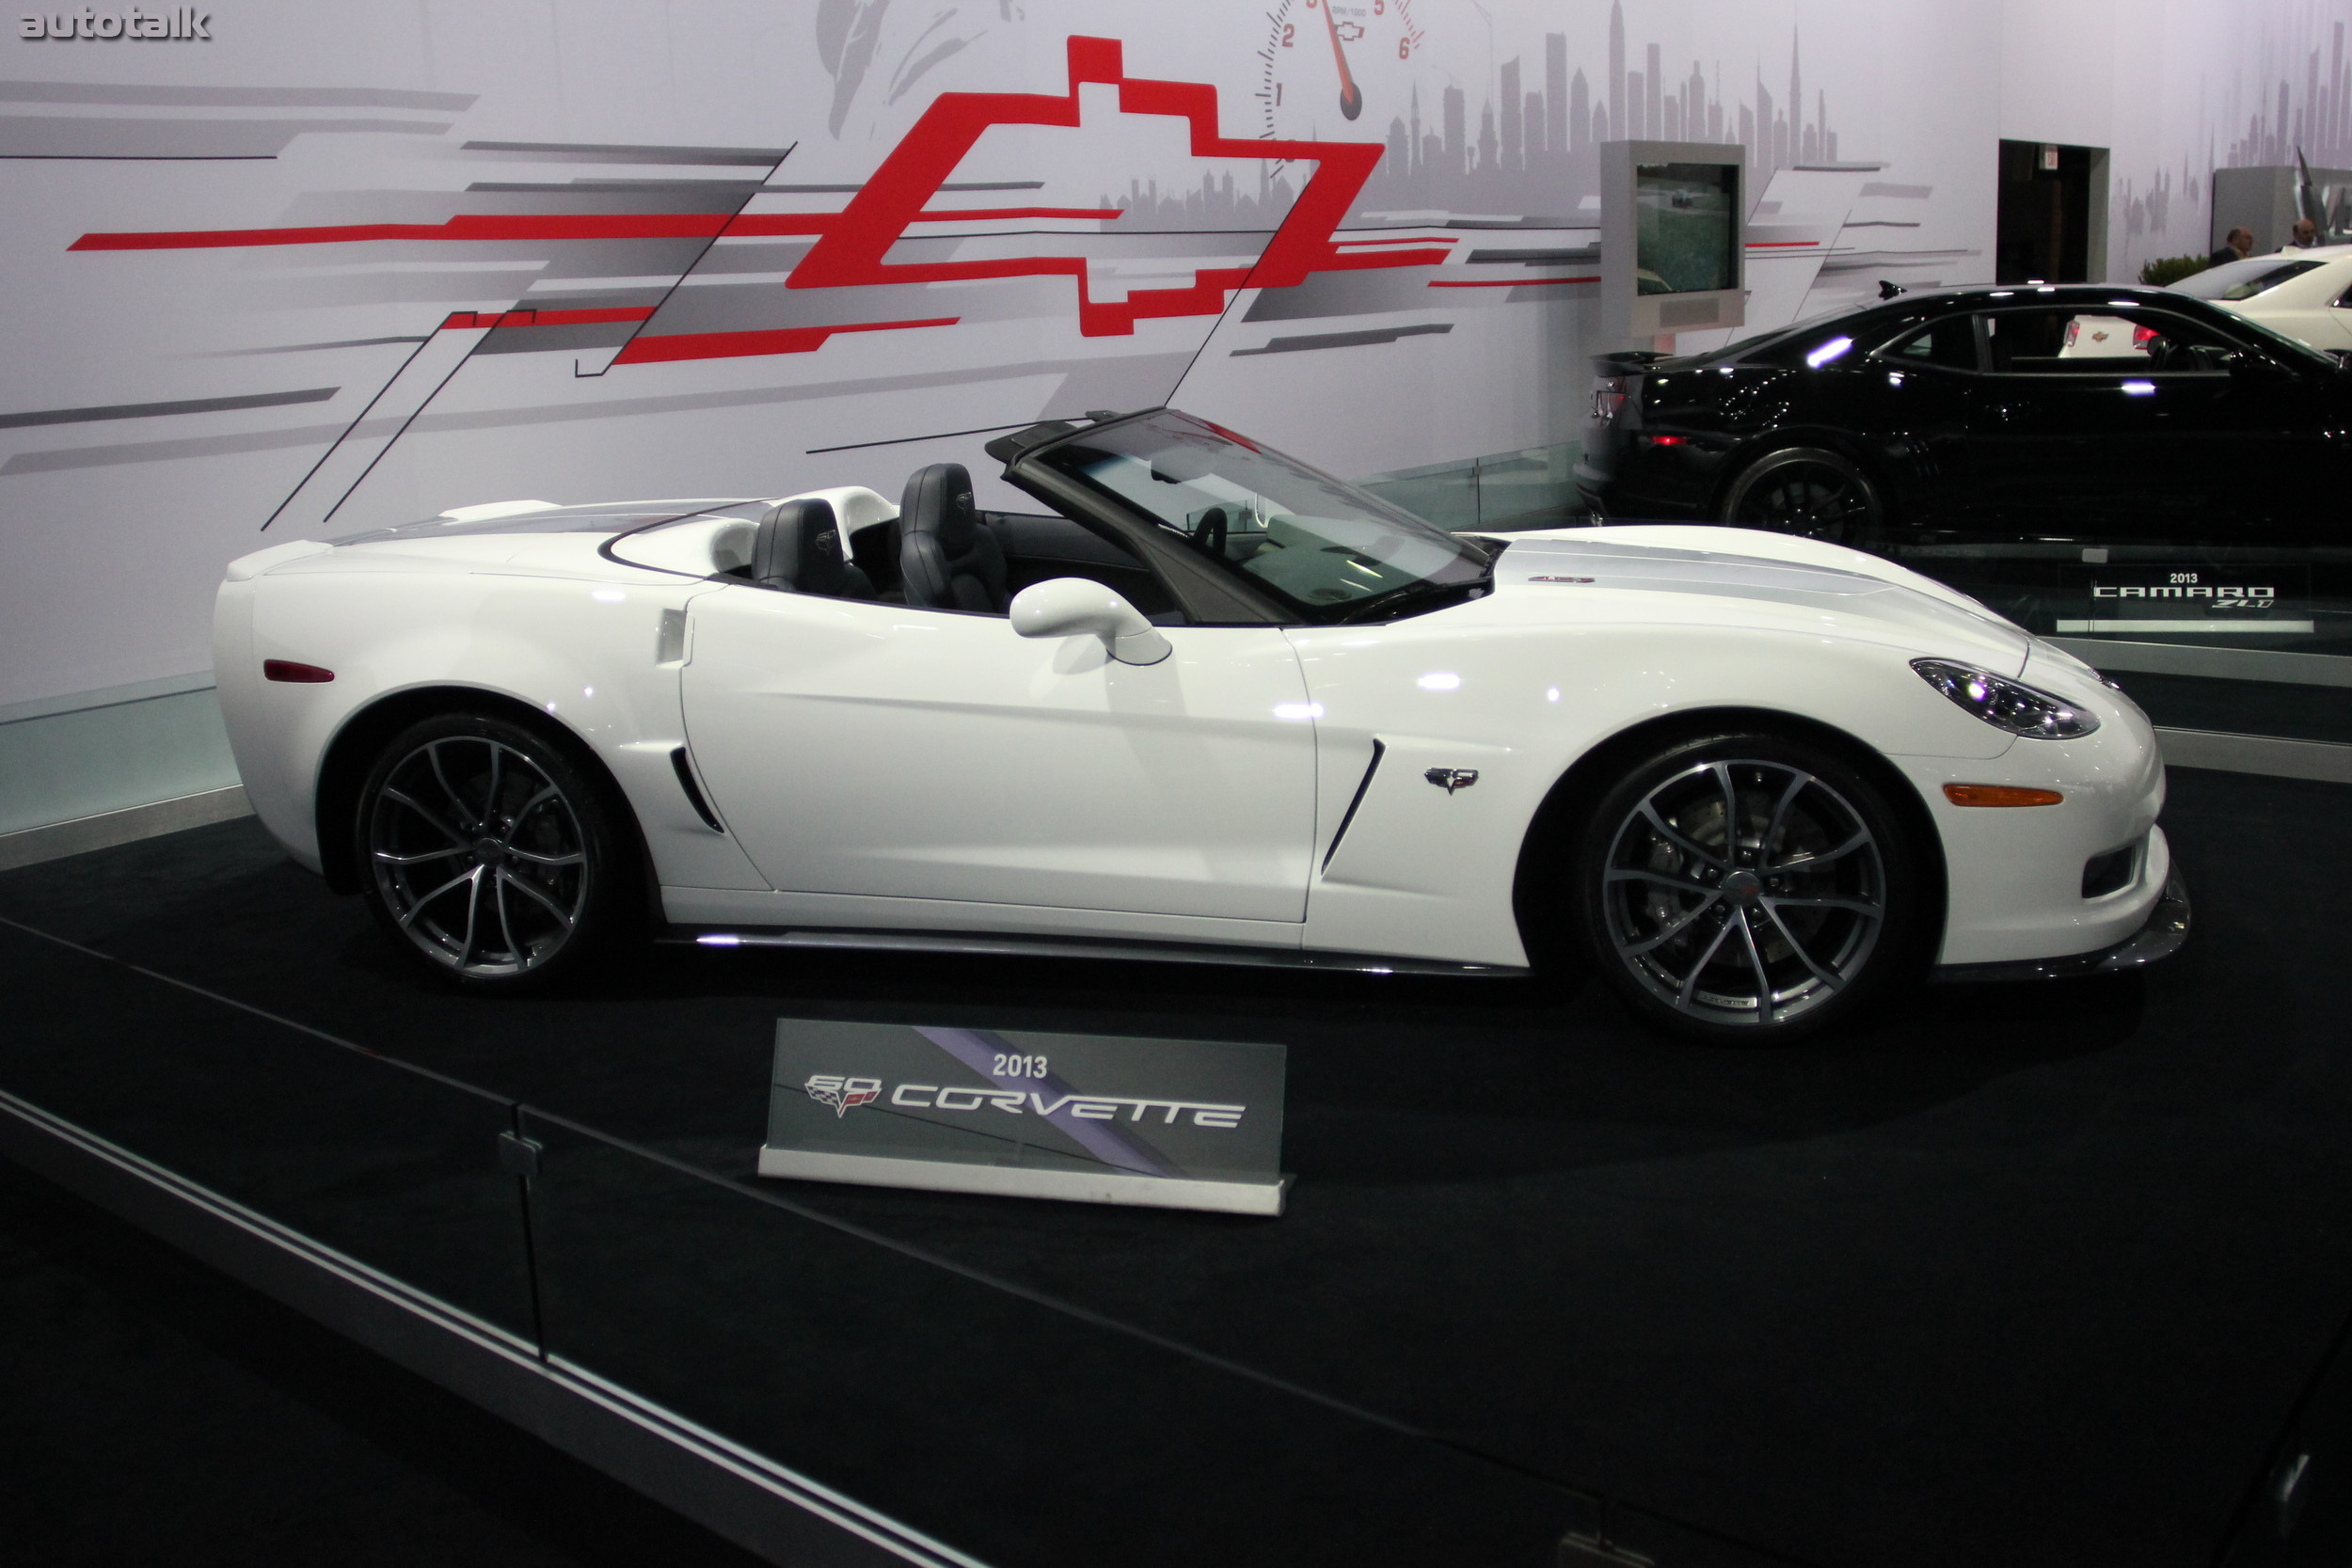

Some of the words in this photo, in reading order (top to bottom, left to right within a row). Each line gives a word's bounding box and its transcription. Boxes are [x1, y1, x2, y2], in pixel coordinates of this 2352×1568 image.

[1281, 24, 1295, 48] 2
[1399, 37, 1411, 60] 6
[1276, 83, 1283, 107] 1
[2169, 573, 2199, 584] 2013
[2093, 587, 2275, 598] CAMARO
[2211, 599, 2275, 609] ZL1
[993, 1053, 1048, 1080] 2013
[890, 1085, 1247, 1129] CORVETTE
